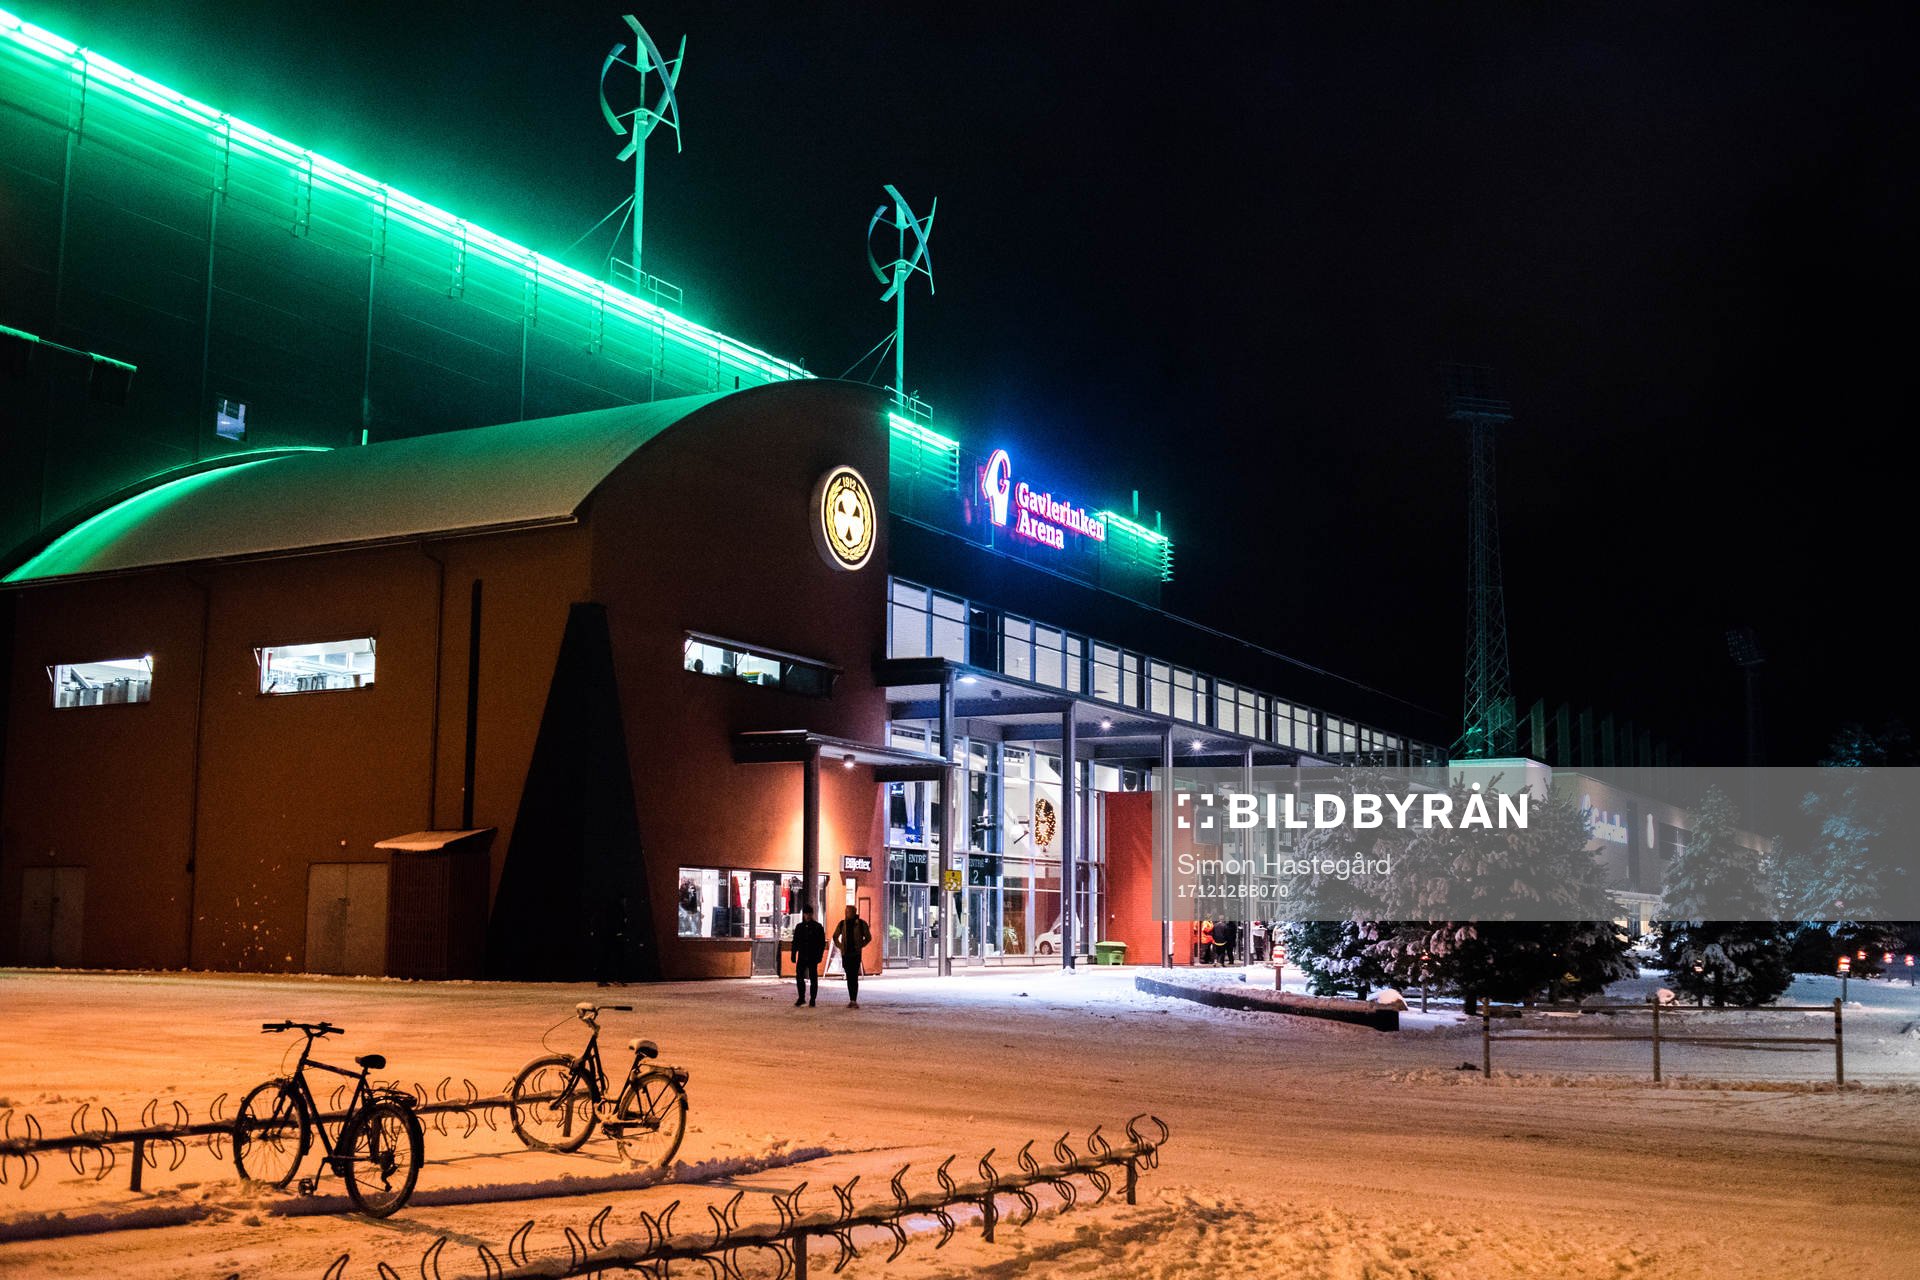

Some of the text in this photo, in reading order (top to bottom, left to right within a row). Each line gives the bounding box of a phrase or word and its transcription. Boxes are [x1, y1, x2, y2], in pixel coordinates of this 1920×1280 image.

[842, 476, 857, 489] 1912
[1015, 481, 1106, 541] Gavlerinken
[1016, 508, 1064, 550] Arena
[914, 866, 920, 880] 1
[973, 869, 979, 883] 2
